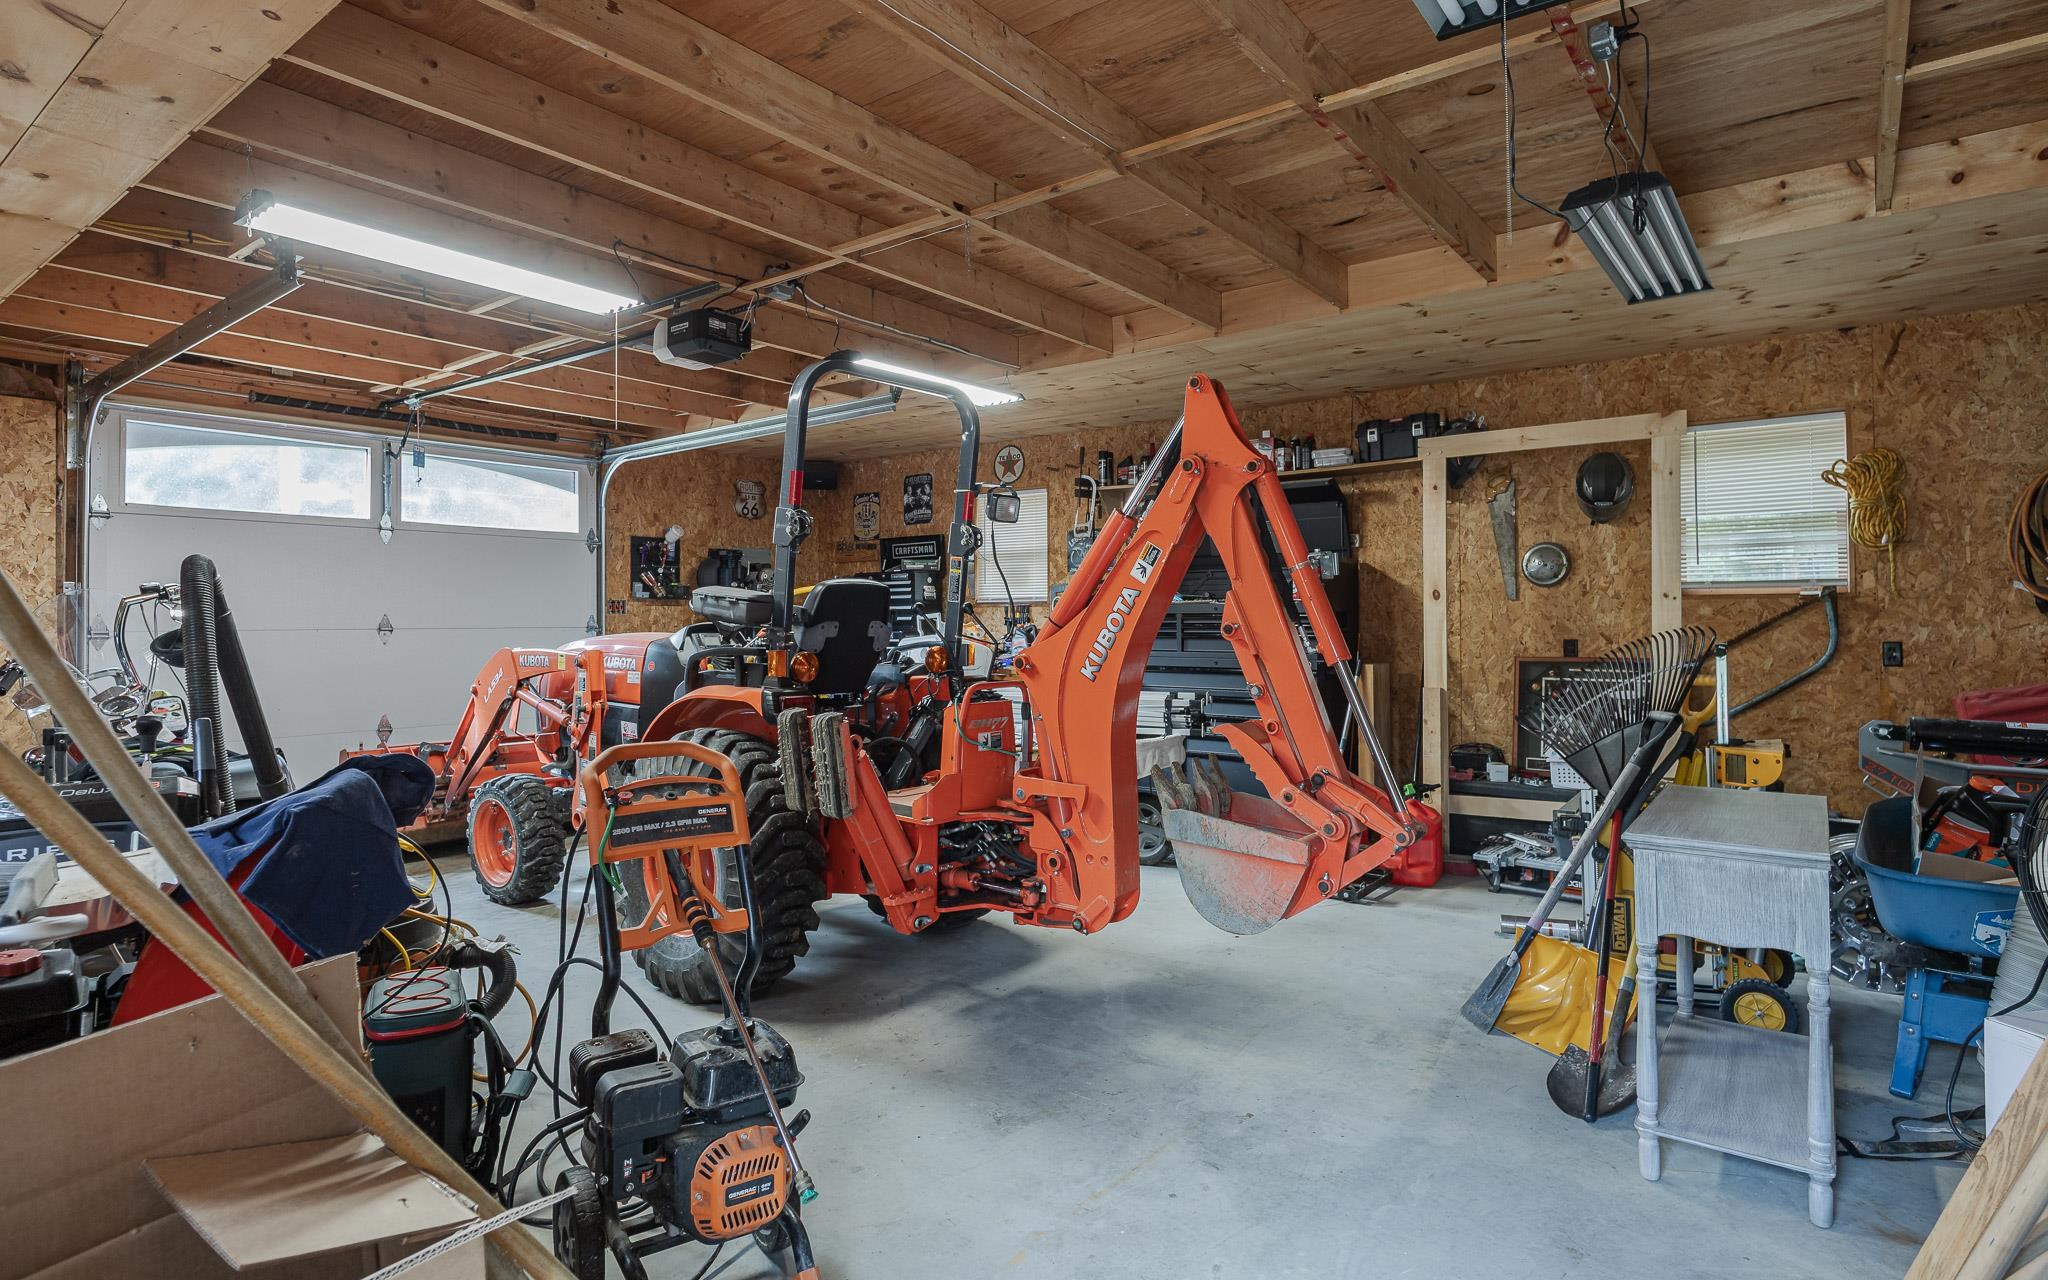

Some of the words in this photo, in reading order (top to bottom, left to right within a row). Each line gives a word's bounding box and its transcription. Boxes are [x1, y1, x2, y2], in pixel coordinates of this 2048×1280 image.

[741, 502, 759, 517] 66
[895, 544, 934, 556] CRAFTSMAN
[1080, 586, 1142, 682] KUBOTA
[519, 655, 549, 667] KUBOTA
[603, 655, 636, 670] KUBOTA
[59, 787, 112, 797] Delu
[698, 807, 727, 815] GENERAC
[644, 822, 661, 831] MAX
[664, 820, 676, 828] 2.3
[677, 818, 692, 827] GPM
[693, 816, 708, 825] MAX
[1613, 900, 1627, 950] DEWALT
[728, 1185, 757, 1199] GENERAC
